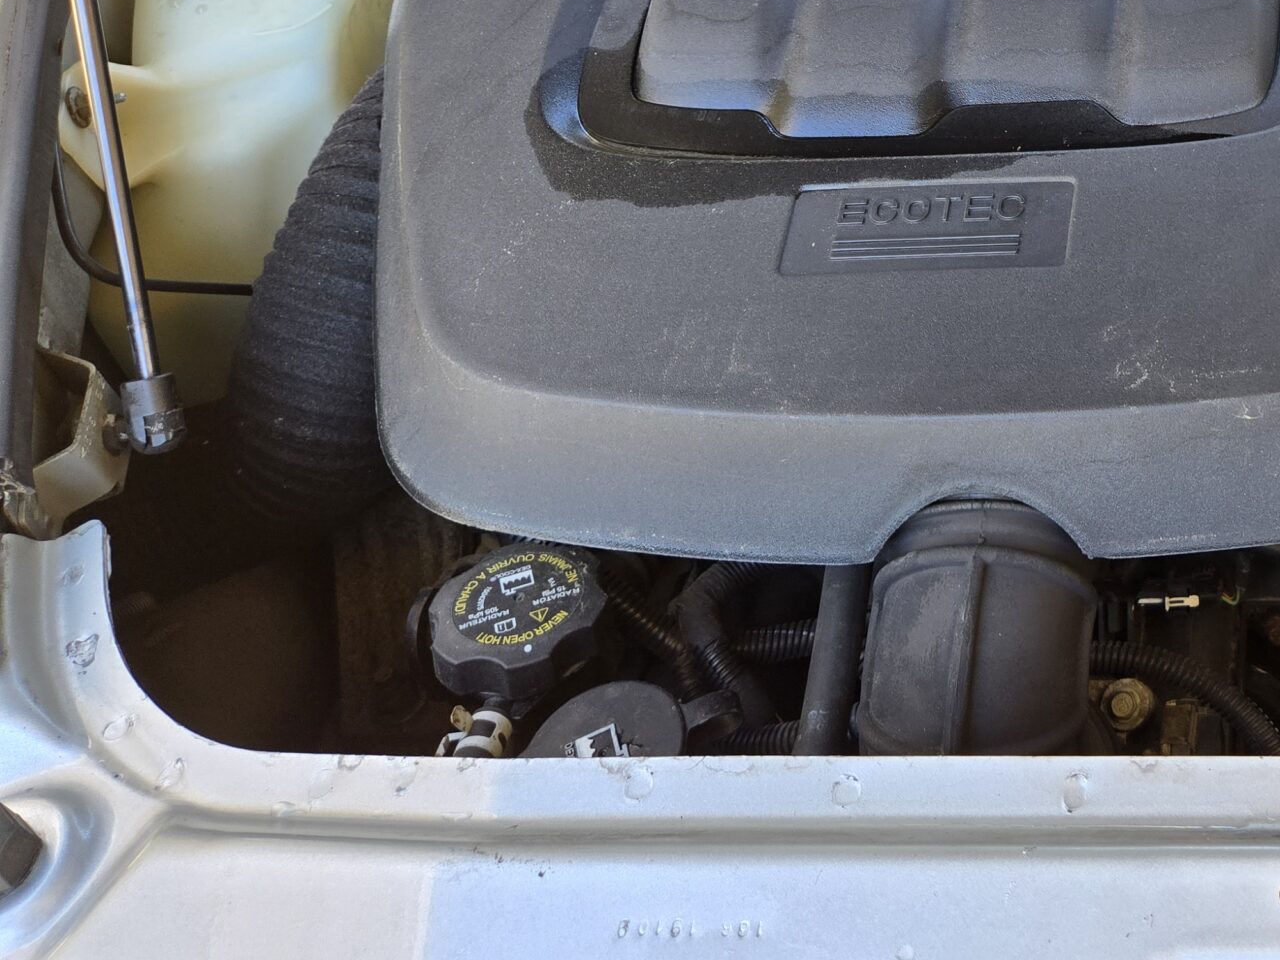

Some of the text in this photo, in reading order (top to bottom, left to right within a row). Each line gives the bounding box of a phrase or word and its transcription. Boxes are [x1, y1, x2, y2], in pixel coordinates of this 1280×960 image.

[836, 192, 1026, 226] ECOTEC
[486, 553, 535, 575] OUVRIR
[538, 553, 572, 574] JAMAIS
[564, 568, 580, 584] NE
[454, 580, 478, 616] CHAUD!
[531, 587, 580, 606] RADIATOR
[541, 587, 556, 597] PSI
[458, 608, 510, 631] RADIATEUR
[475, 610, 568, 646] NEVER OPEN HOT!
